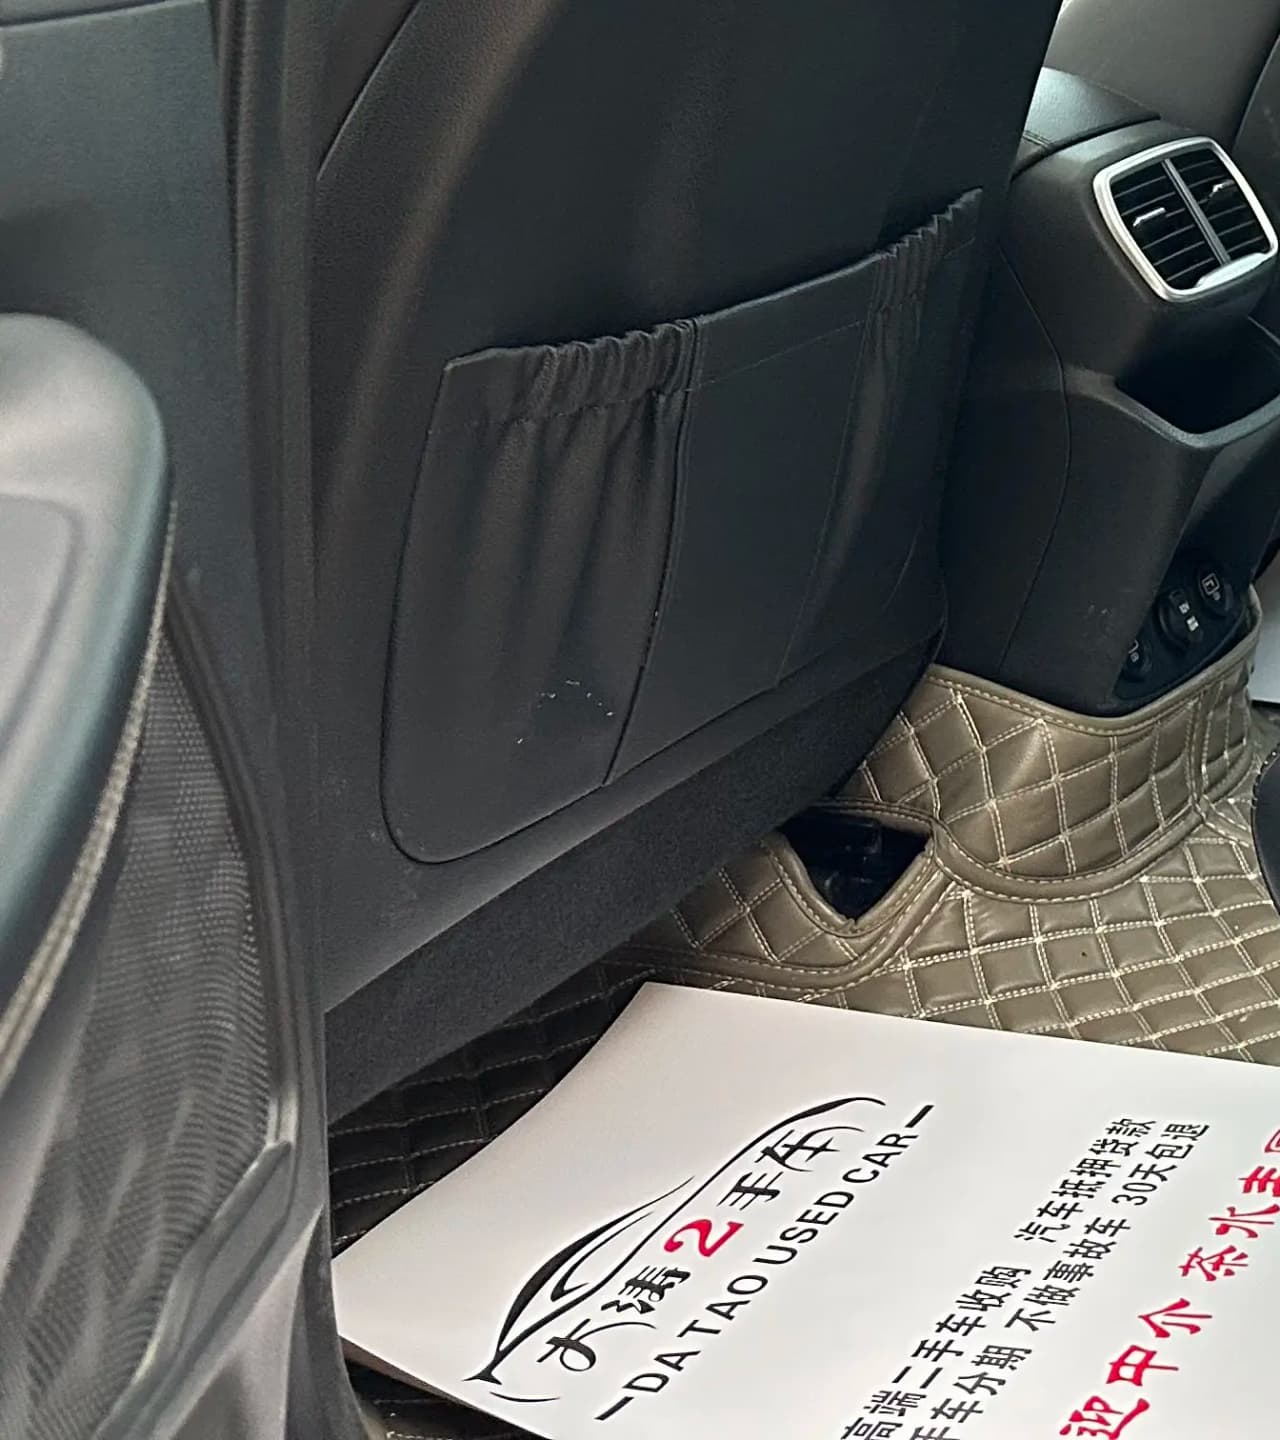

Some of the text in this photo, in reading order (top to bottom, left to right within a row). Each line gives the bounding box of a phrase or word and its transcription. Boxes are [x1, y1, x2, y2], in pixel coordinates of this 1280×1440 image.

[753, 1191, 854, 1265] USED
[842, 1132, 918, 1184] CAR
[1111, 1123, 1211, 1206] 30天包退
